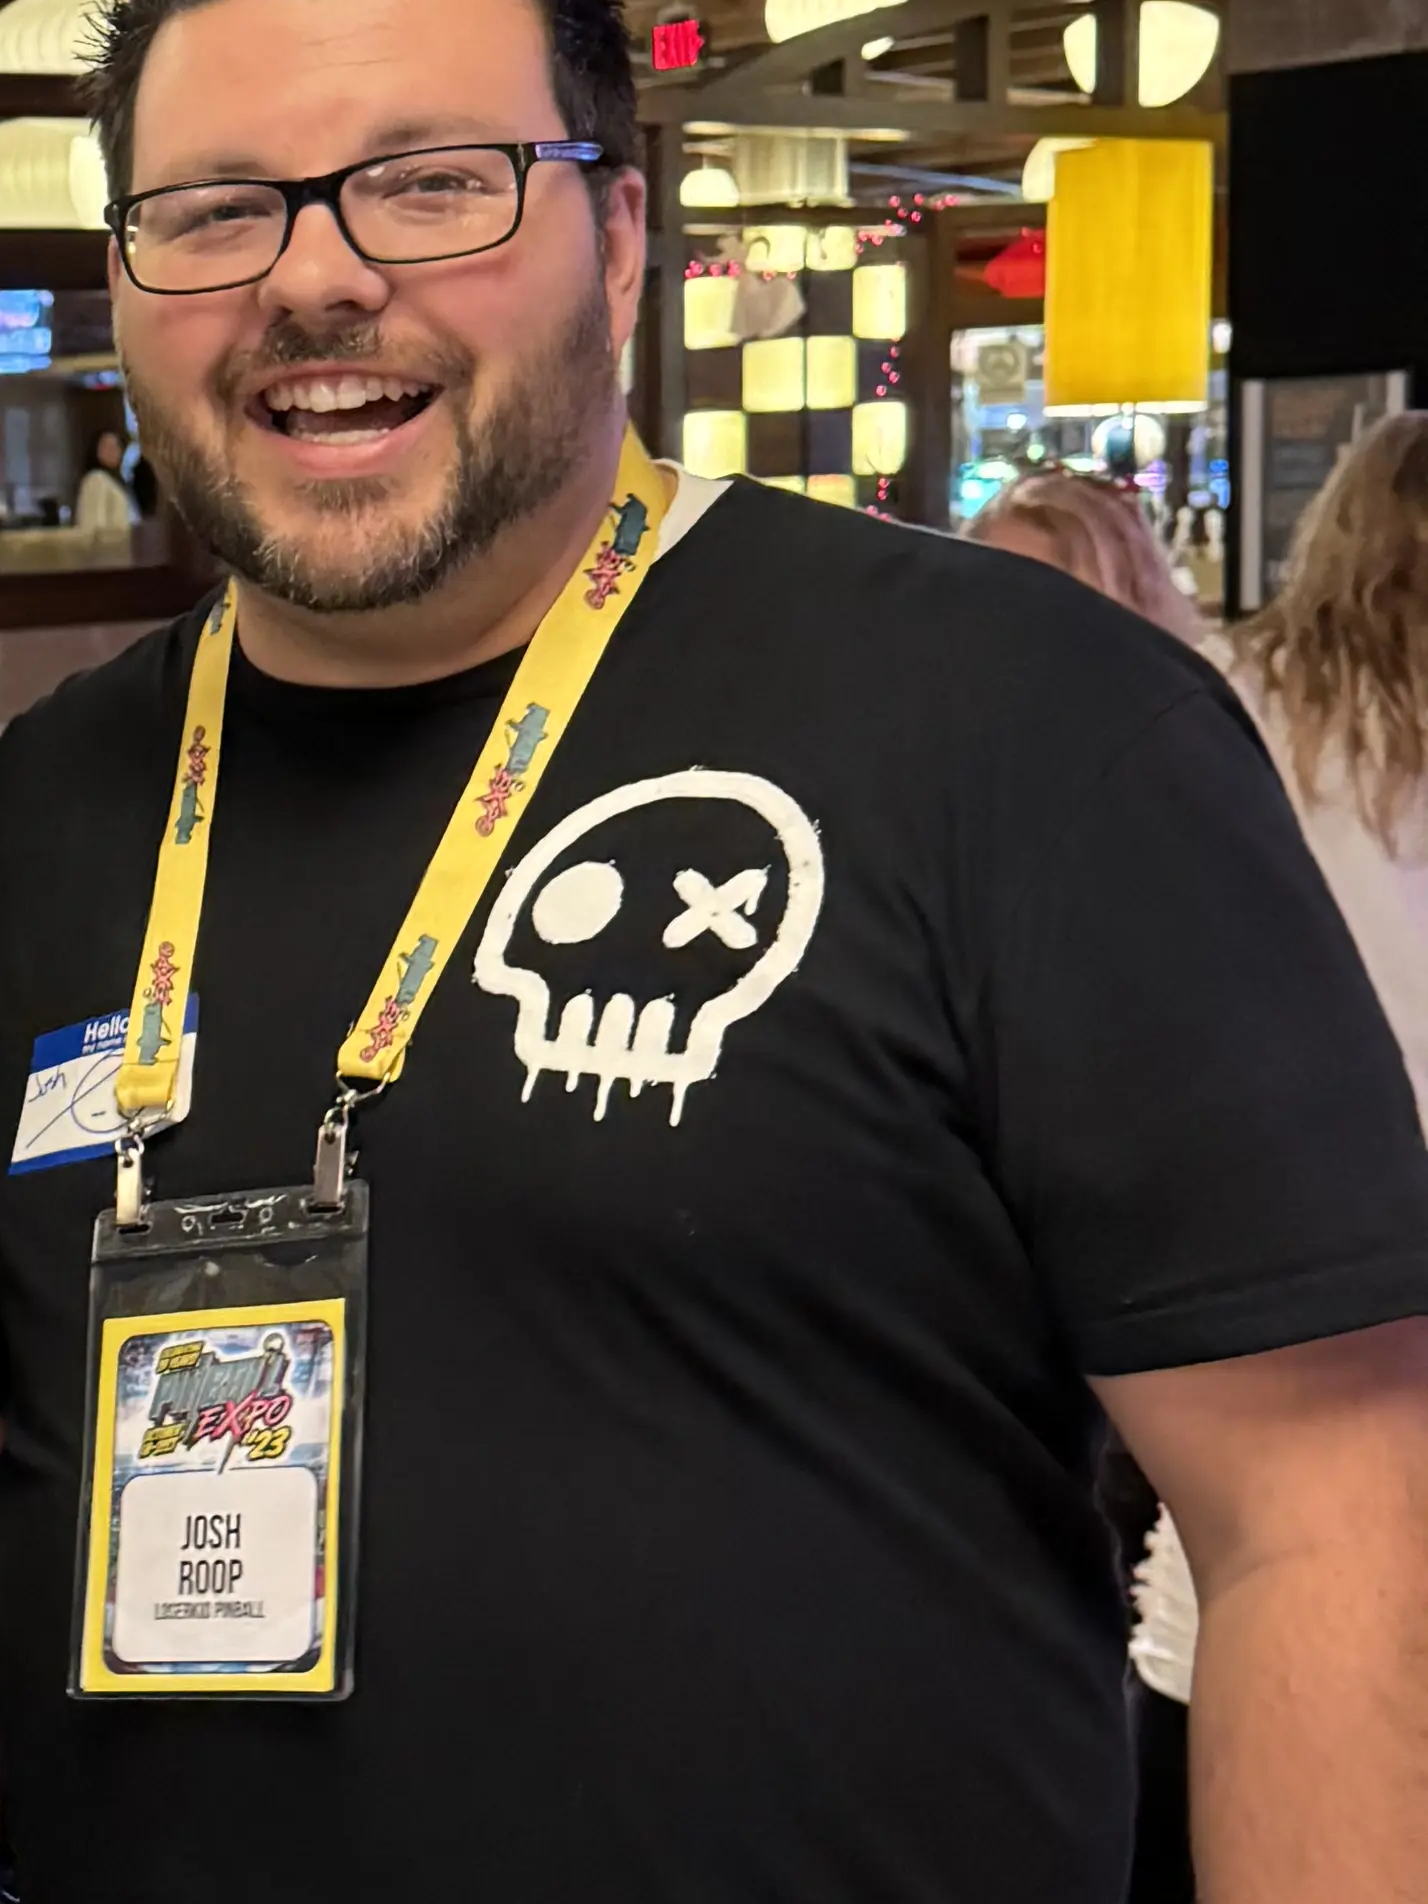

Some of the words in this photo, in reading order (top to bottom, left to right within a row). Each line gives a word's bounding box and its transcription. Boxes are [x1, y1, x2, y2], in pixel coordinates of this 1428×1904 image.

[193, 1390, 293, 1443] EXPO
[243, 1425, 292, 1461] '23
[180, 1513, 241, 1550] JOSH
[178, 1559, 243, 1595] ROOP
